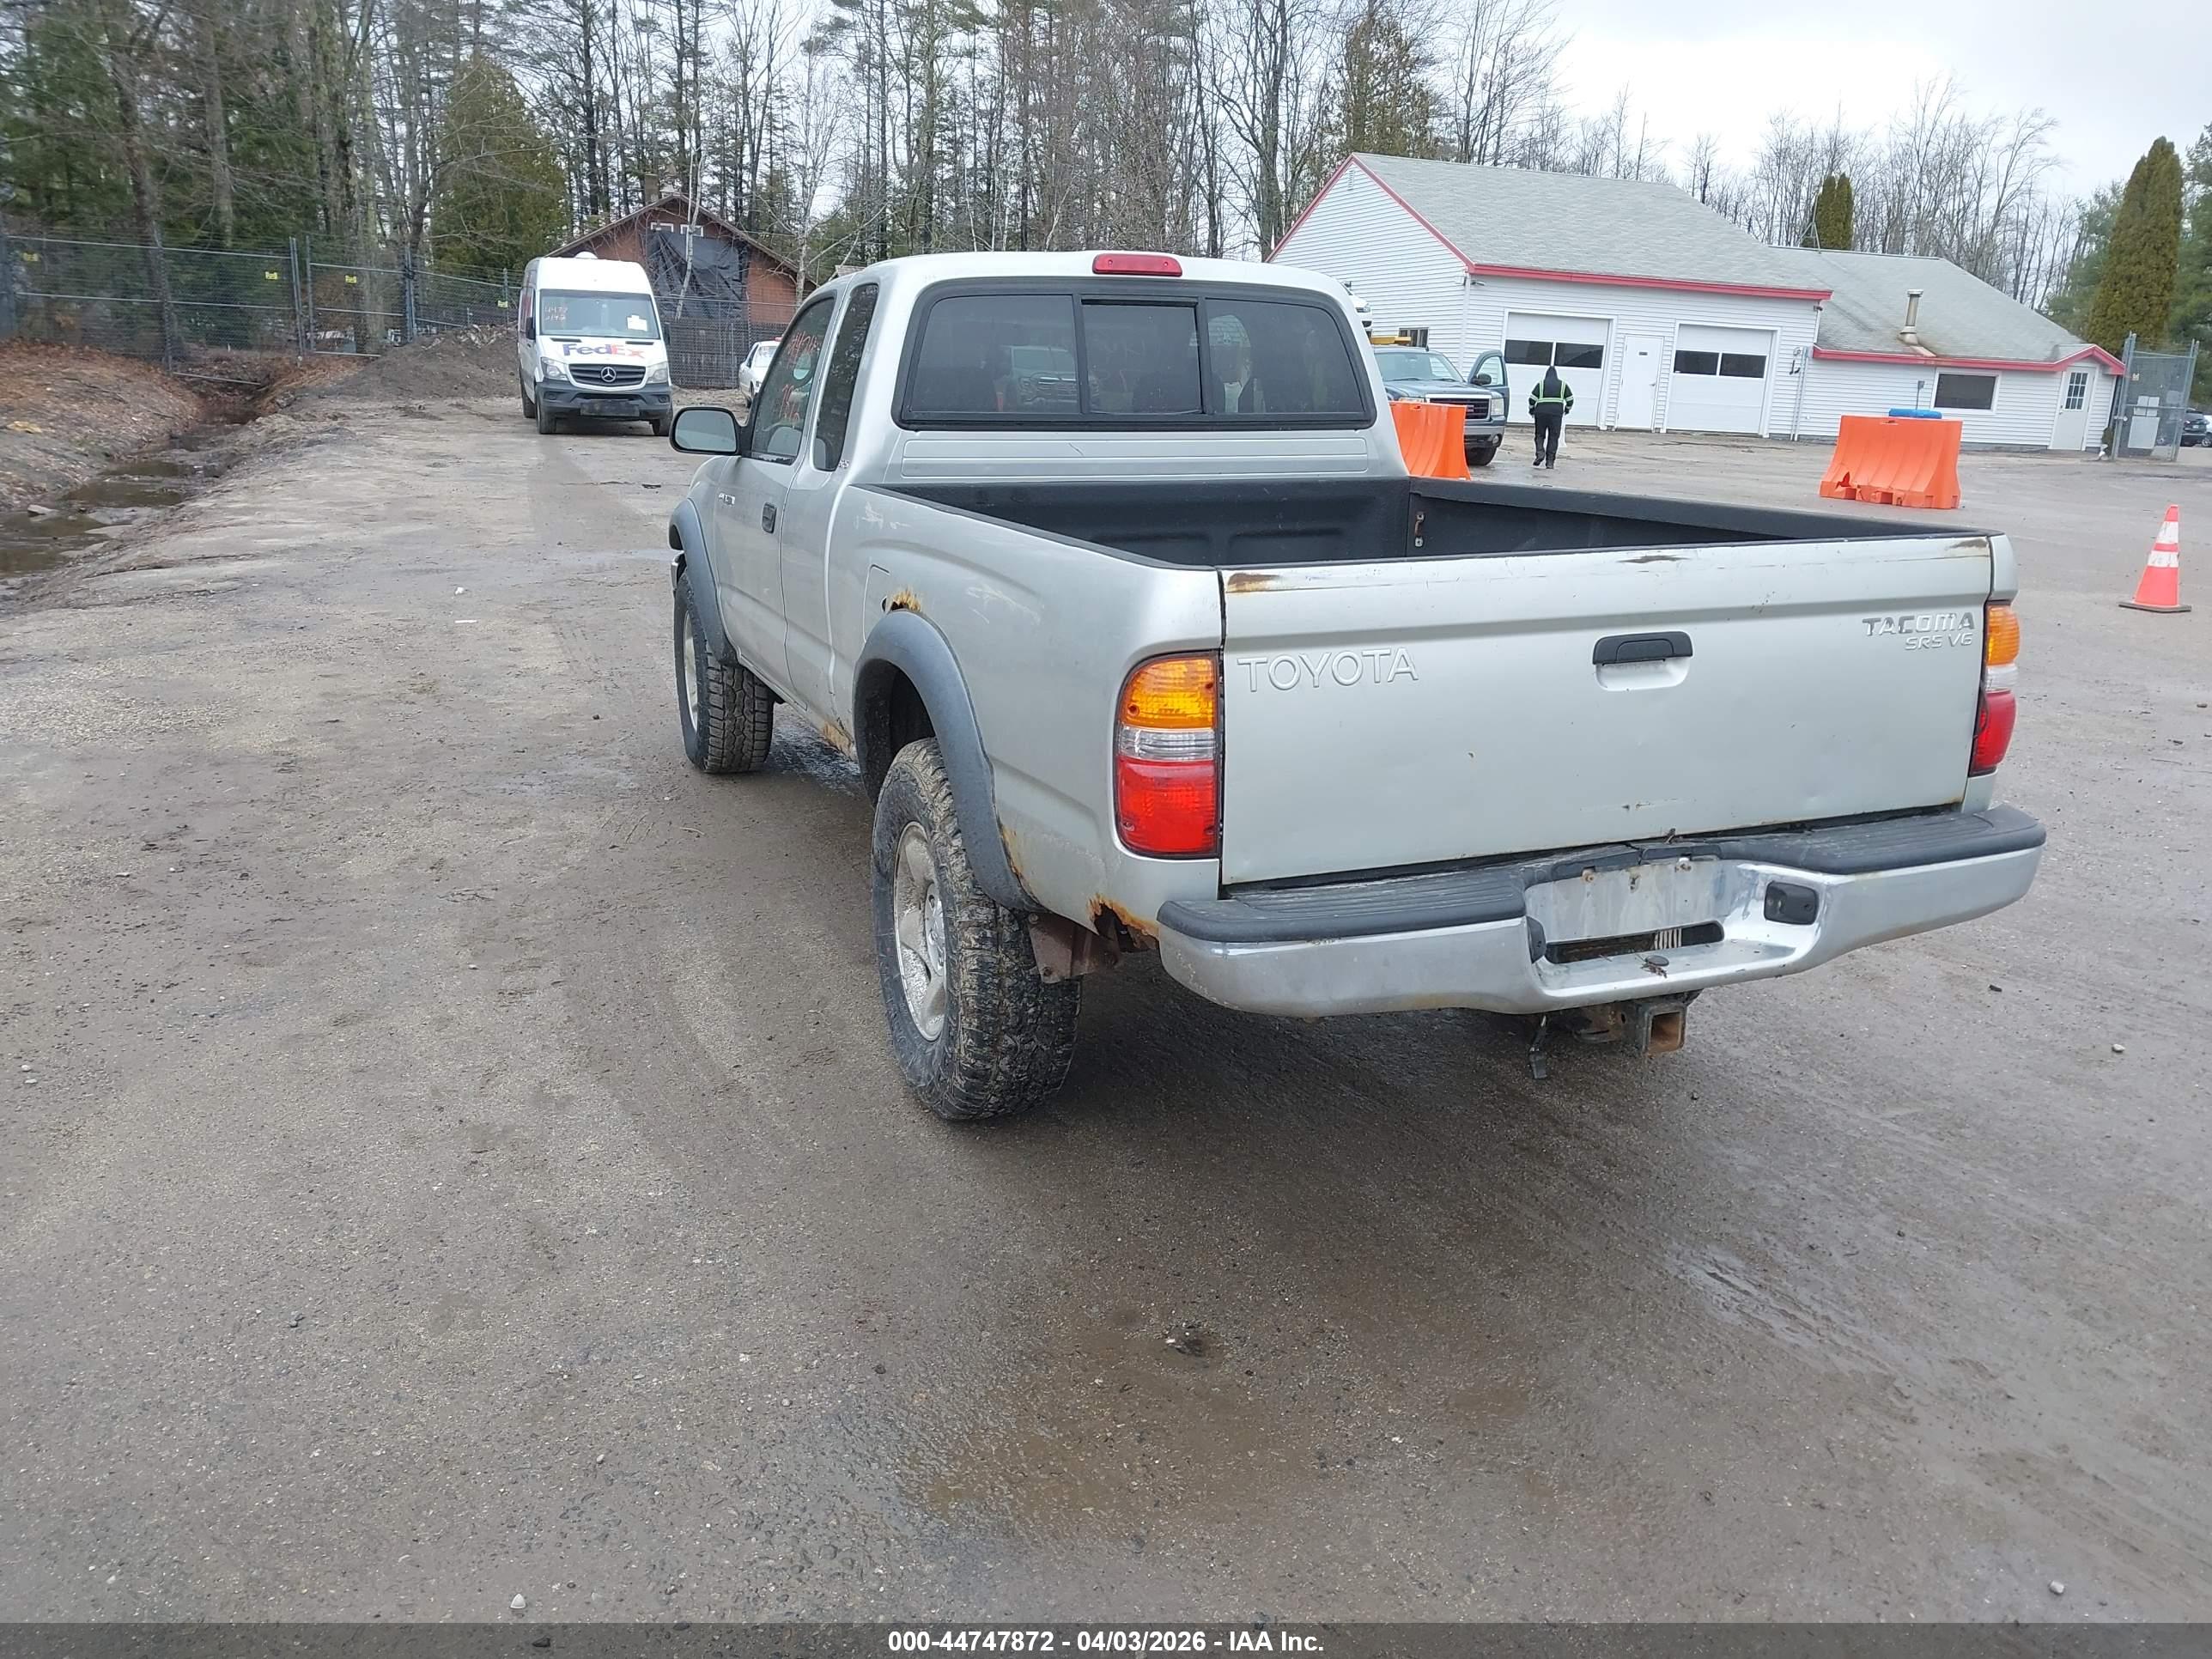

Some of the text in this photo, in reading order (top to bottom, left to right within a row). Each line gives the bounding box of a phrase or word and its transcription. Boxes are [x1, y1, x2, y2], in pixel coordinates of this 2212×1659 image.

[562, 343, 645, 358] FedEx
[1862, 612, 1975, 636] TACOMA
[1905, 632, 1972, 650] SR5 V6
[1237, 647, 1419, 693] TOYOTA
